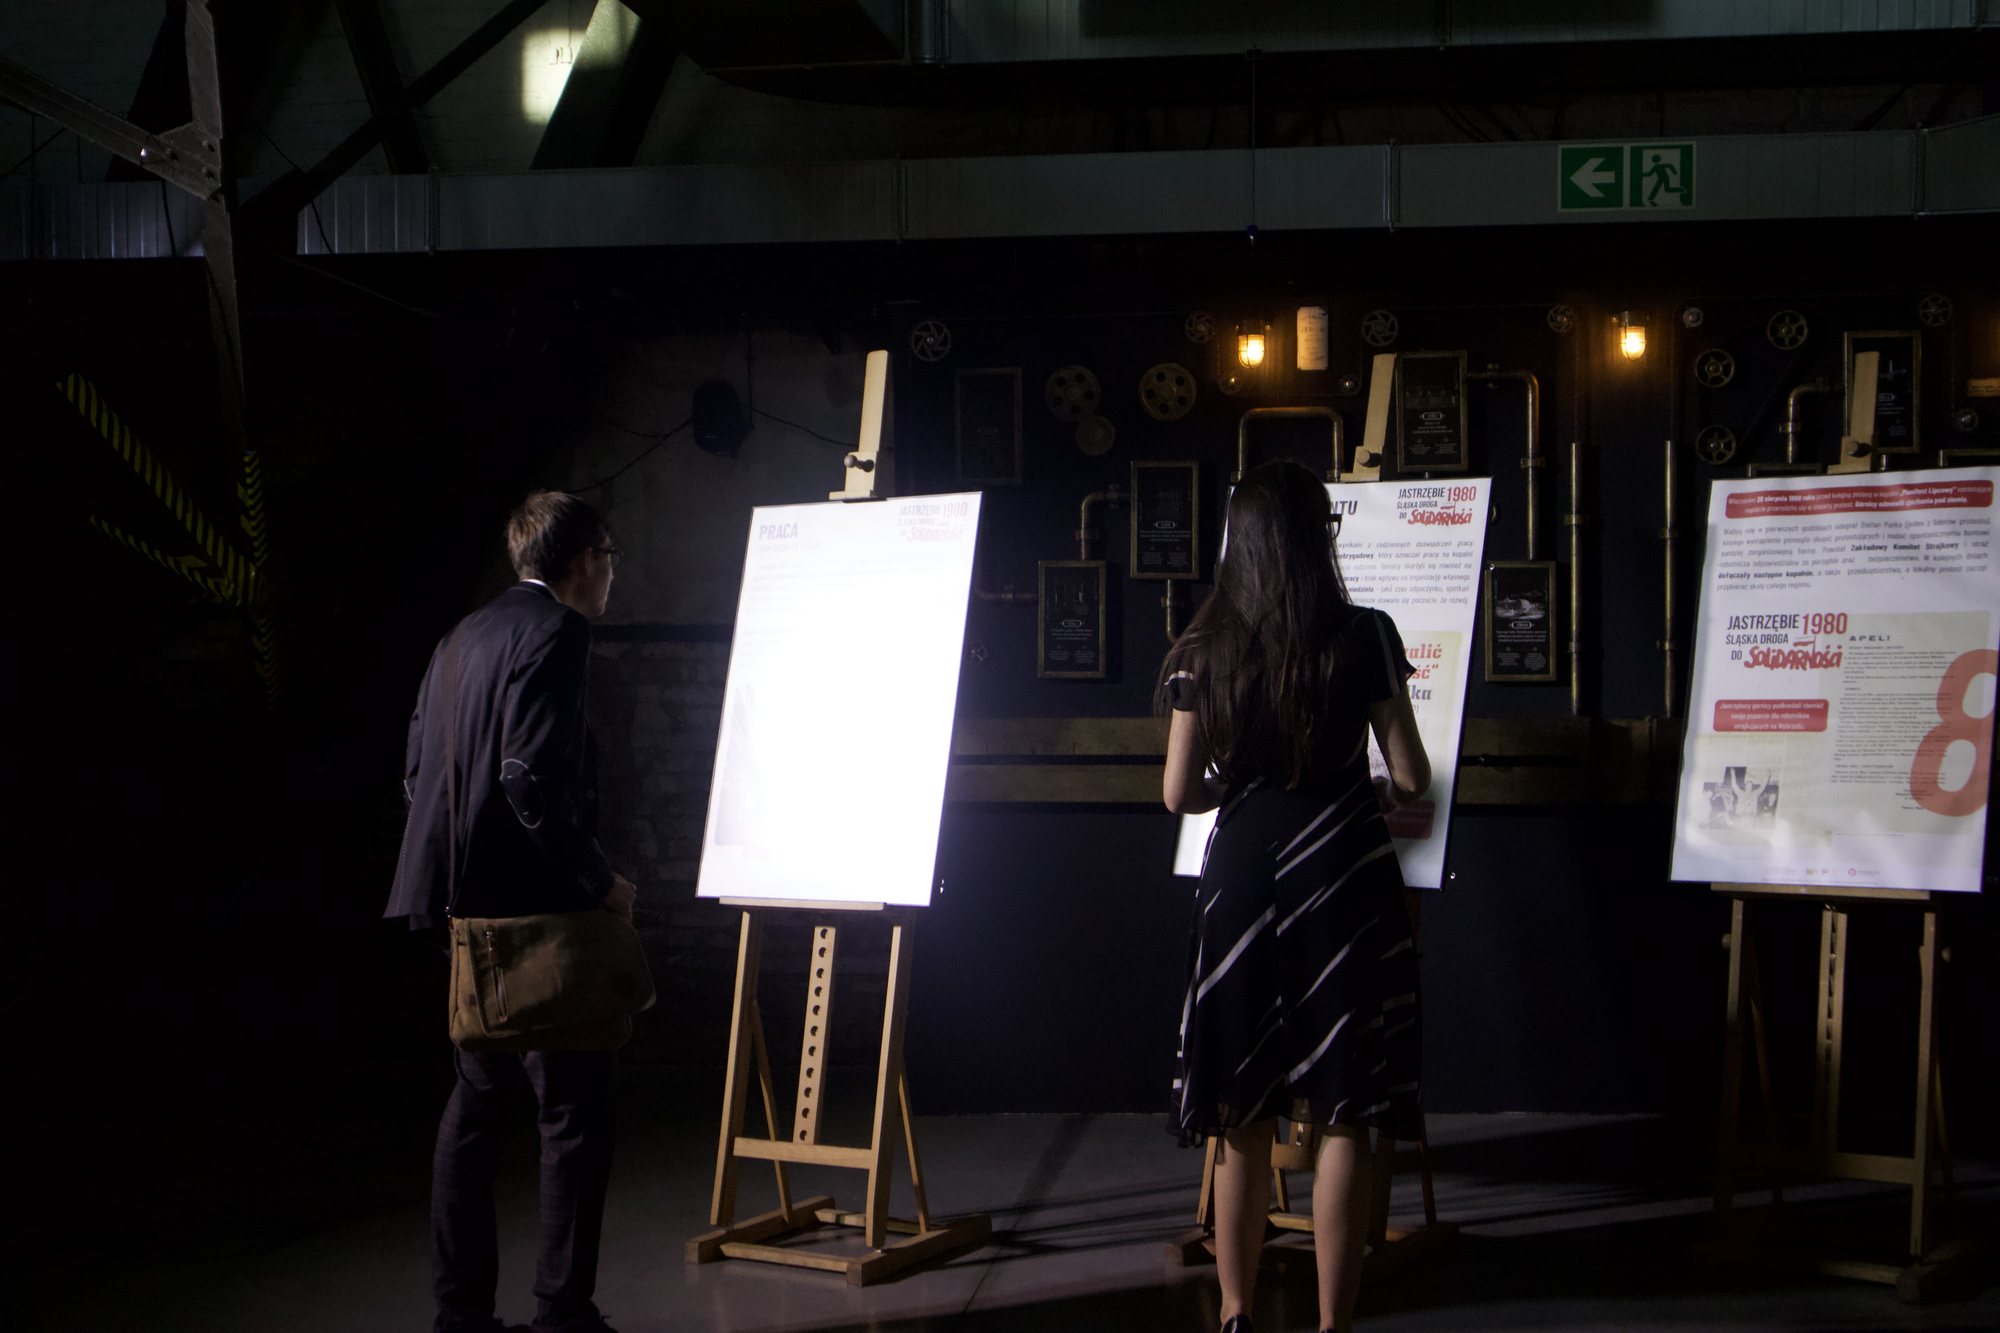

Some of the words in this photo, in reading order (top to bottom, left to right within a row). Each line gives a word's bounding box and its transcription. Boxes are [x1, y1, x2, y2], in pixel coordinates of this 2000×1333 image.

[1397, 487, 1446, 501] JASTRZĘBIE
[1446, 486, 1477, 503] 1980
[943, 502, 968, 518] 1980
[1396, 500, 1418, 513] ŚLĄSKA
[1418, 500, 1438, 509] DROGA
[1399, 511, 1407, 520] DO
[758, 522, 799, 541] PRACA
[1893, 542, 1920, 551] Komitet
[1727, 614, 1800, 633] JASTRZĘBIE
[1802, 612, 1848, 636] 1980
[1726, 634, 1758, 647] ŚLĄSKA
[1760, 634, 1789, 645] DROGA
[1731, 650, 1743, 661] DO
[1909, 648, 1998, 818] 8
